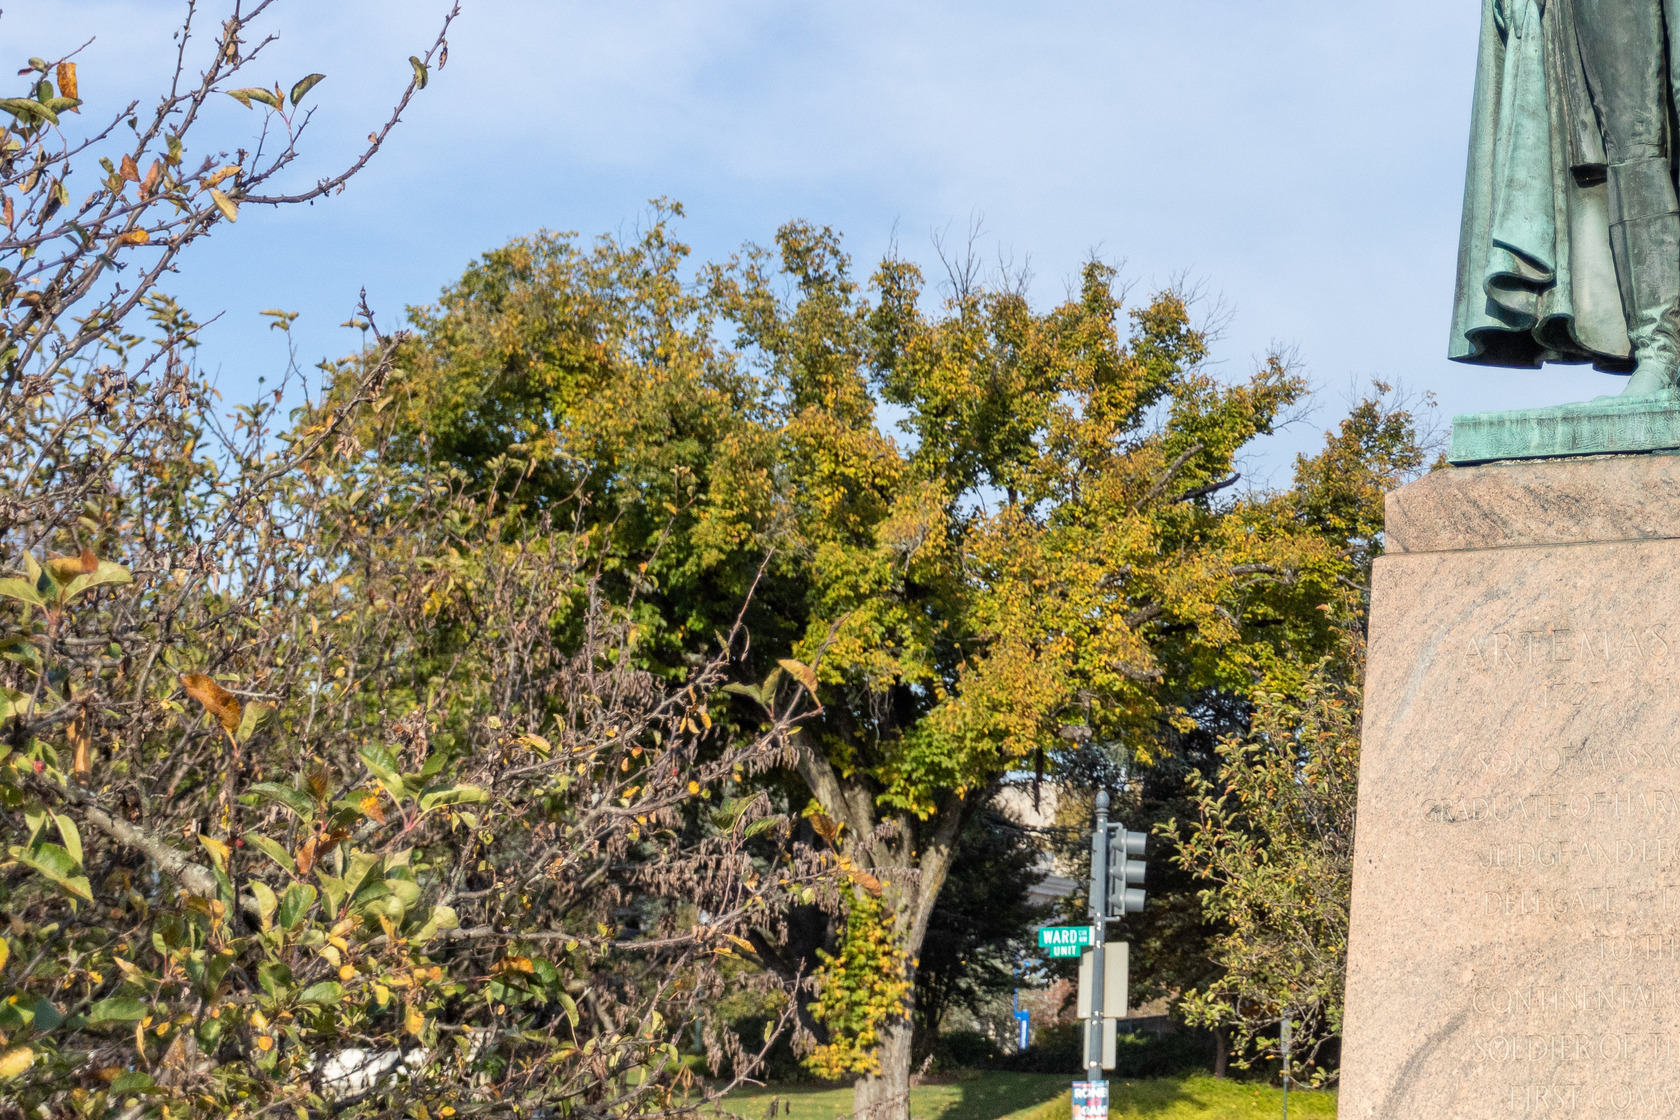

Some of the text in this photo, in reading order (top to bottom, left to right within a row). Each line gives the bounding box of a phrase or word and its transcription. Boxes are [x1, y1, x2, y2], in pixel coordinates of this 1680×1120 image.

[1462, 623, 1668, 666] ARTEMAS
[1477, 748, 1531, 776] SON
[1539, 746, 1575, 774] OF
[1420, 793, 1561, 823] GRADUATE
[1569, 791, 1606, 819] OF
[1479, 840, 1571, 869] JUDGE
[1577, 838, 1634, 866] AND
[1484, 887, 1617, 916] DELEGATE
[1043, 930, 1078, 945] WARD
[1053, 945, 1076, 957] UNIT
[1595, 935, 1633, 961] TO
[1473, 984, 1664, 1014] CONTINENTAL
[1473, 1034, 1592, 1063] SOLDIER
[1600, 1033, 1637, 1060] OF
[1509, 1083, 1581, 1111] FIRST
